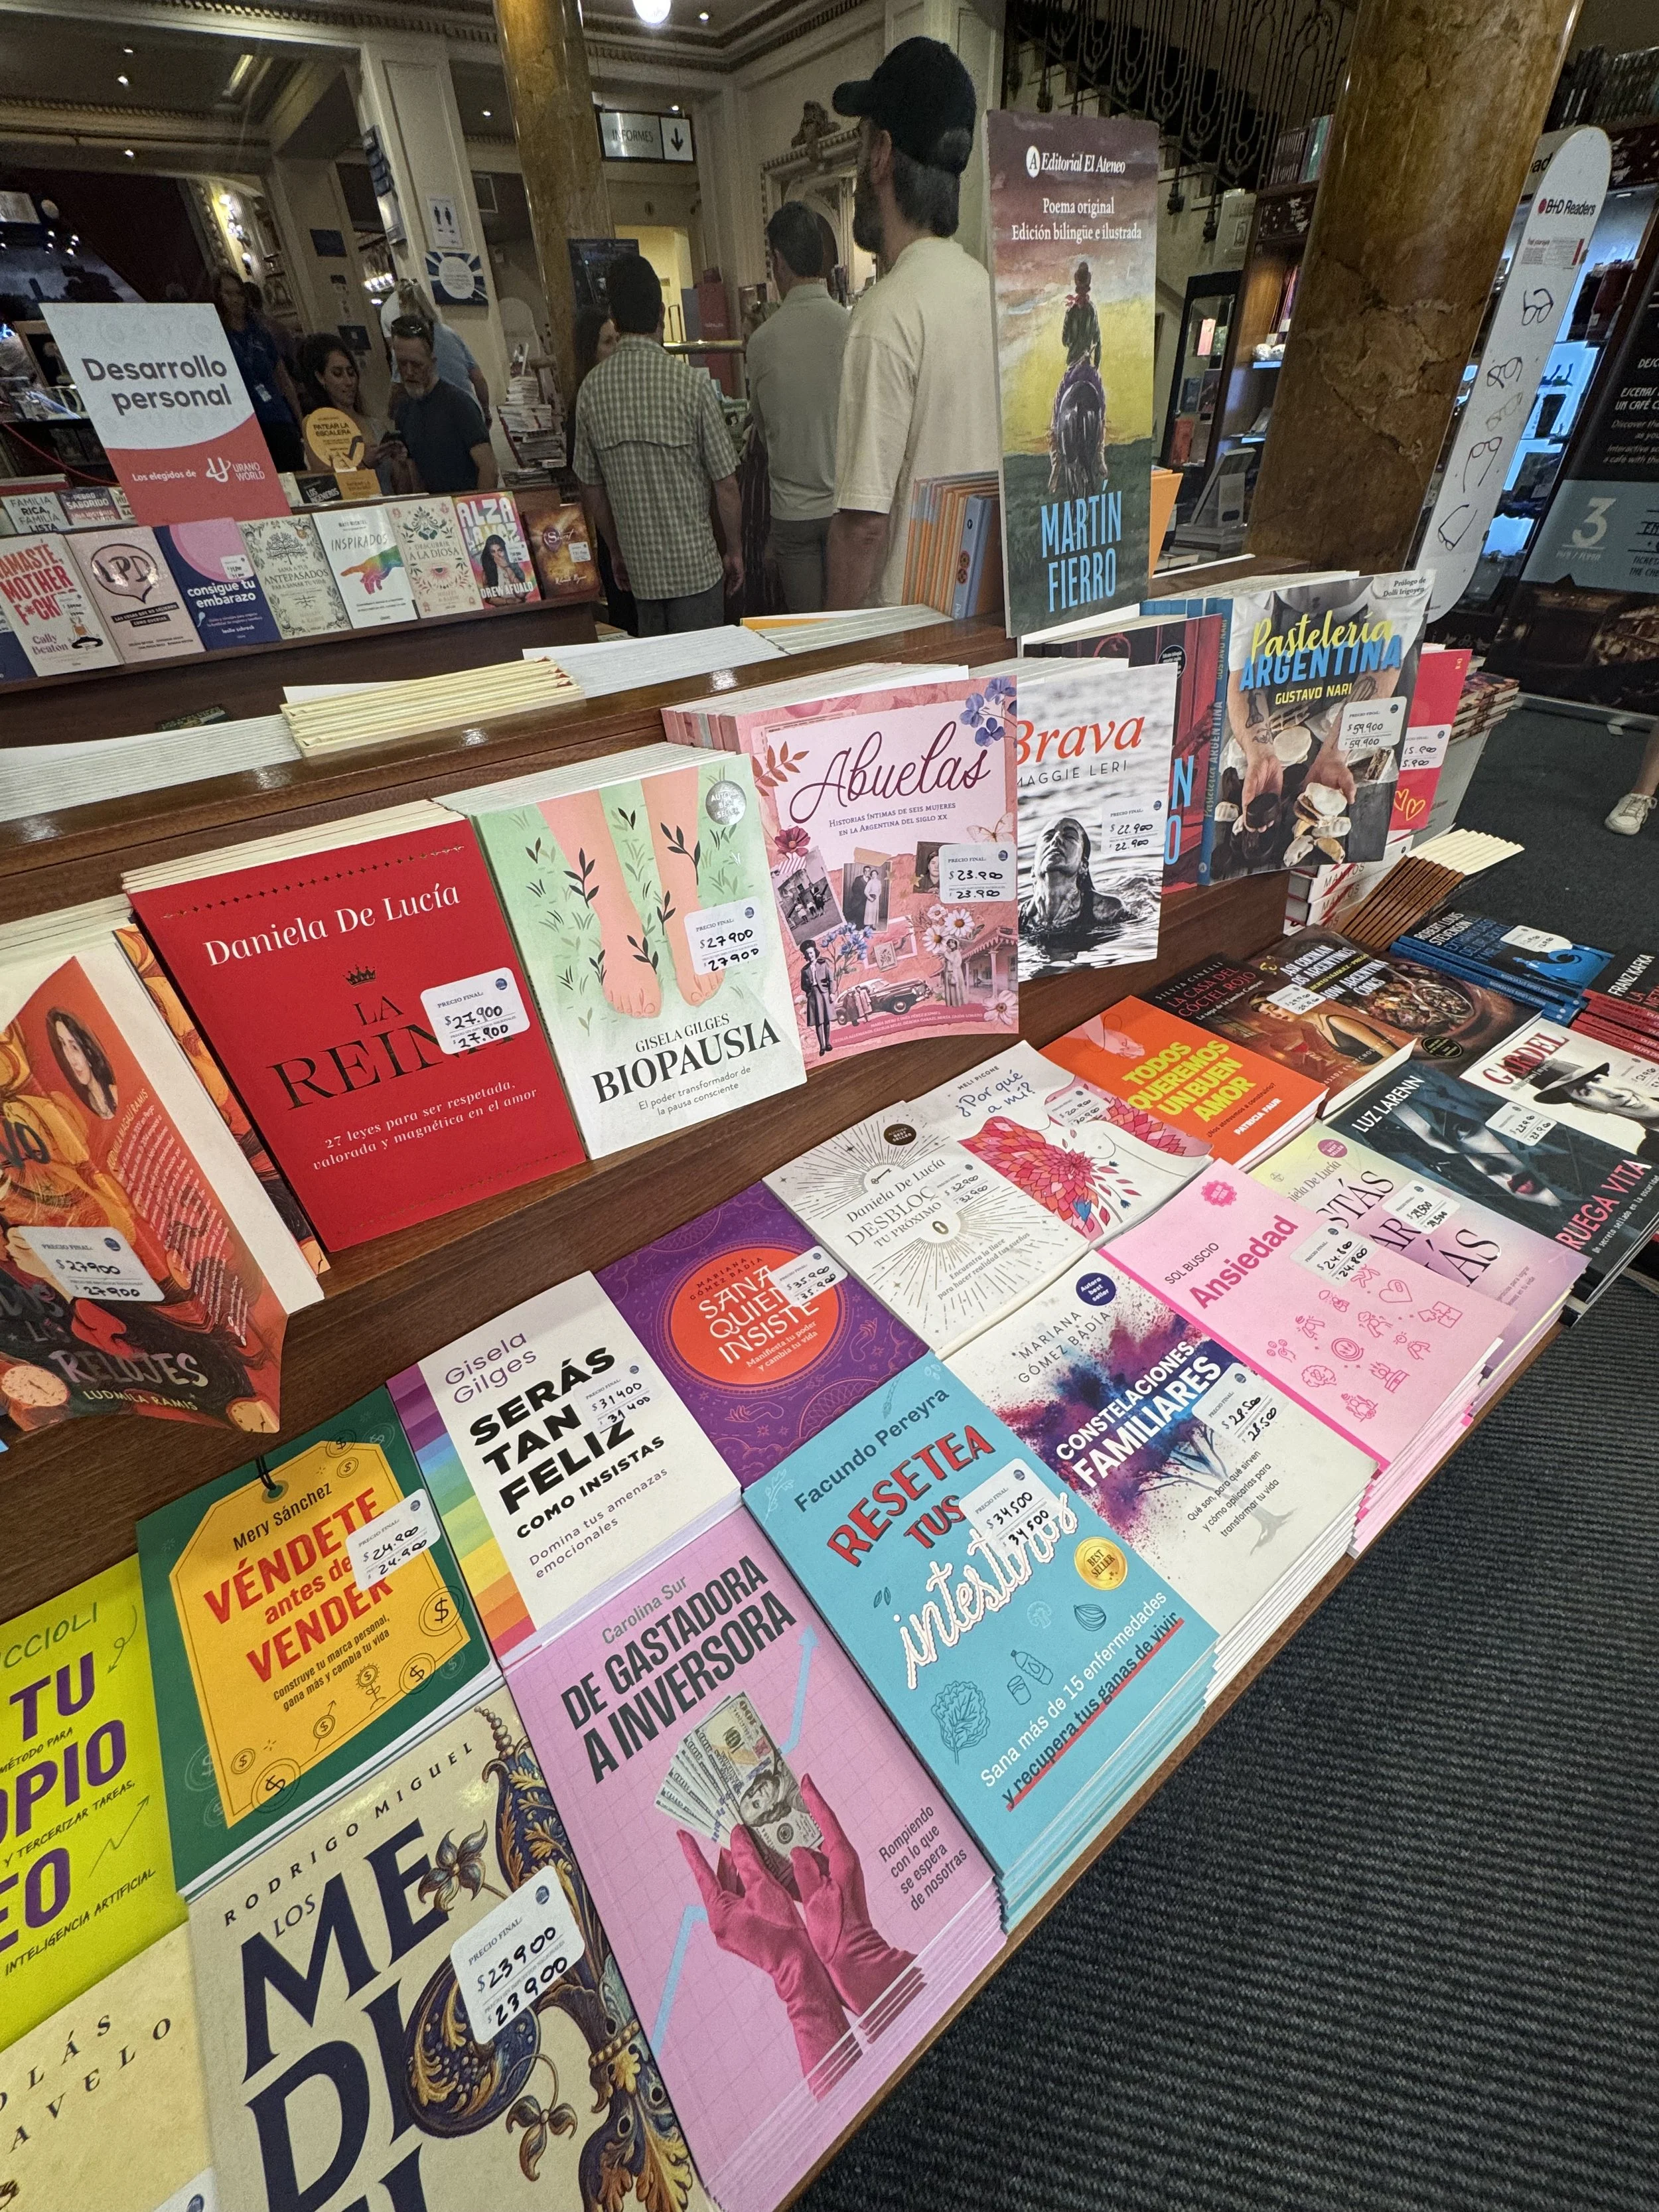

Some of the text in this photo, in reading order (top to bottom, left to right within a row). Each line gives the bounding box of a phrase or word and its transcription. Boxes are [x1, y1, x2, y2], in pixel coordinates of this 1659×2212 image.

[612, 129, 653, 143] INFORMES
[1041, 153, 1125, 174] Editorial El Ateneo
[1043, 196, 1115, 218] Poema original
[1563, 200, 1595, 216] Readers
[1011, 222, 1141, 244] Edición bilingüe e ilustrada
[82, 355, 226, 382] Desarrollo
[111, 384, 232, 415] personal
[132, 469, 196, 482] Los elegidos de
[233, 462, 260, 473] URANO
[236, 471, 265, 482] WORLD
[10, 496, 51, 507] FAMILIA
[19, 515, 60, 526] FAMILIA
[66, 499, 109, 509] SABORIDO
[457, 497, 515, 527] ALZA
[1041, 479, 1122, 558] MARTÍN
[1572, 497, 1617, 547] 3
[332, 533, 389, 551] INSPIRADOS
[187, 580, 255, 597] consigue tu
[196, 594, 256, 609] embarazo
[265, 569, 329, 585] ANTEPASADOS
[480, 581, 533, 599] DREW AFUALO
[1048, 548, 1116, 613] FIERRO
[1252, 611, 1393, 664] Pastelería
[1240, 634, 1402, 692] ARGENTINA
[1275, 683, 1352, 705] GUSTAVO NARI
[790, 721, 991, 824] Abuelas
[1090, 760, 1127, 776] LERI
[202, 883, 461, 966] Daniela De Lucía
[1413, 912, 1465, 940] ROBERT LOUIS
[1429, 920, 1473, 946] STEVENSON
[1155, 962, 1224, 1000] SILVIA CINELLI
[1222, 972, 1256, 991] ROJO
[1303, 947, 1357, 978] ARGENTINOS
[1352, 977, 1386, 996] COOKS
[1607, 954, 1656, 997] FRANZ KAFKA
[352, 995, 404, 1026] LA
[437, 996, 462, 1009] PRECIO
[635, 1013, 731, 1053] GISELA GILGES
[591, 1017, 781, 1104] BIOPAUSIA
[957, 1065, 999, 1090] MELI PICONE
[1121, 1041, 1191, 1085] TODOS
[1127, 1040, 1230, 1110] QUEREMOS
[638, 1065, 751, 1111] El poder transformador de
[988, 1082, 1036, 1114] a mí?
[1157, 1057, 1244, 1116] UN BUEN
[1192, 1076, 1257, 1122] AMOR
[1262, 1097, 1283, 1114] FAUR
[1351, 1074, 1425, 1134] LUZ LARENN
[325, 1079, 516, 1149] 27 leyes para ser respetada,
[845, 1157, 946, 1223] Daniela De Lucía
[1601, 1159, 1652, 1193] VITA
[1555, 1195, 1621, 1250] RUEGA
[1164, 1242, 1220, 1286] SOL BUSCIO
[1188, 1215, 1299, 1310] Ansiedad
[698, 1265, 775, 1319] SANA
[718, 1301, 820, 1364] INSISTE
[1019, 1310, 1083, 1360] MARIANA
[48, 1350, 209, 1388] RELOJES
[444, 1332, 528, 1386] Gisela
[453, 1348, 538, 1405] Gilges
[82, 1390, 198, 1410] LUDMILA RAMIS
[469, 1347, 616, 1447] SERÁS
[1055, 1339, 1195, 1461] CONSTELACIONES
[482, 1404, 583, 1476] TAN
[1071, 1355, 1223, 1490] FAMILIARES
[498, 1419, 636, 1516] FELIZ
[793, 1385, 952, 1513] Facundo Pereyra
[516, 1436, 666, 1539] COMO INSISTAS
[826, 1424, 997, 1570] RESETEA
[232, 1479, 334, 1552] Mery Sánchez
[528, 1467, 669, 1567] Domina tus amenazas
[903, 1493, 966, 1550] TUS
[202, 1487, 384, 1626] VÉNDETE
[534, 1516, 620, 1580] emocionales
[1086, 1548, 1106, 1568] BEST
[1089, 1552, 1115, 1580] SELLER
[263, 1557, 354, 1625] antes de
[601, 1575, 688, 1646] Carolina Sur
[245, 1580, 394, 1683] VENDER
[561, 1555, 770, 1731] DE GASTADORA
[9, 1651, 96, 1742] TU
[584, 1589, 798, 1786] A INVERSORA
[980, 1591, 1167, 1787] Sana más de 15 enfermedades
[222, 1741, 474, 1928] RODRIGO MIGUEL
[879, 1806, 934, 1863] Rompiendo
[901, 1844, 948, 1895] se espera
[910, 1849, 967, 1911] de nosotras
[5, 1868, 157, 1976] INTELIGENCIA ARTIFICIAL
[272, 1894, 317, 1939] LOS
